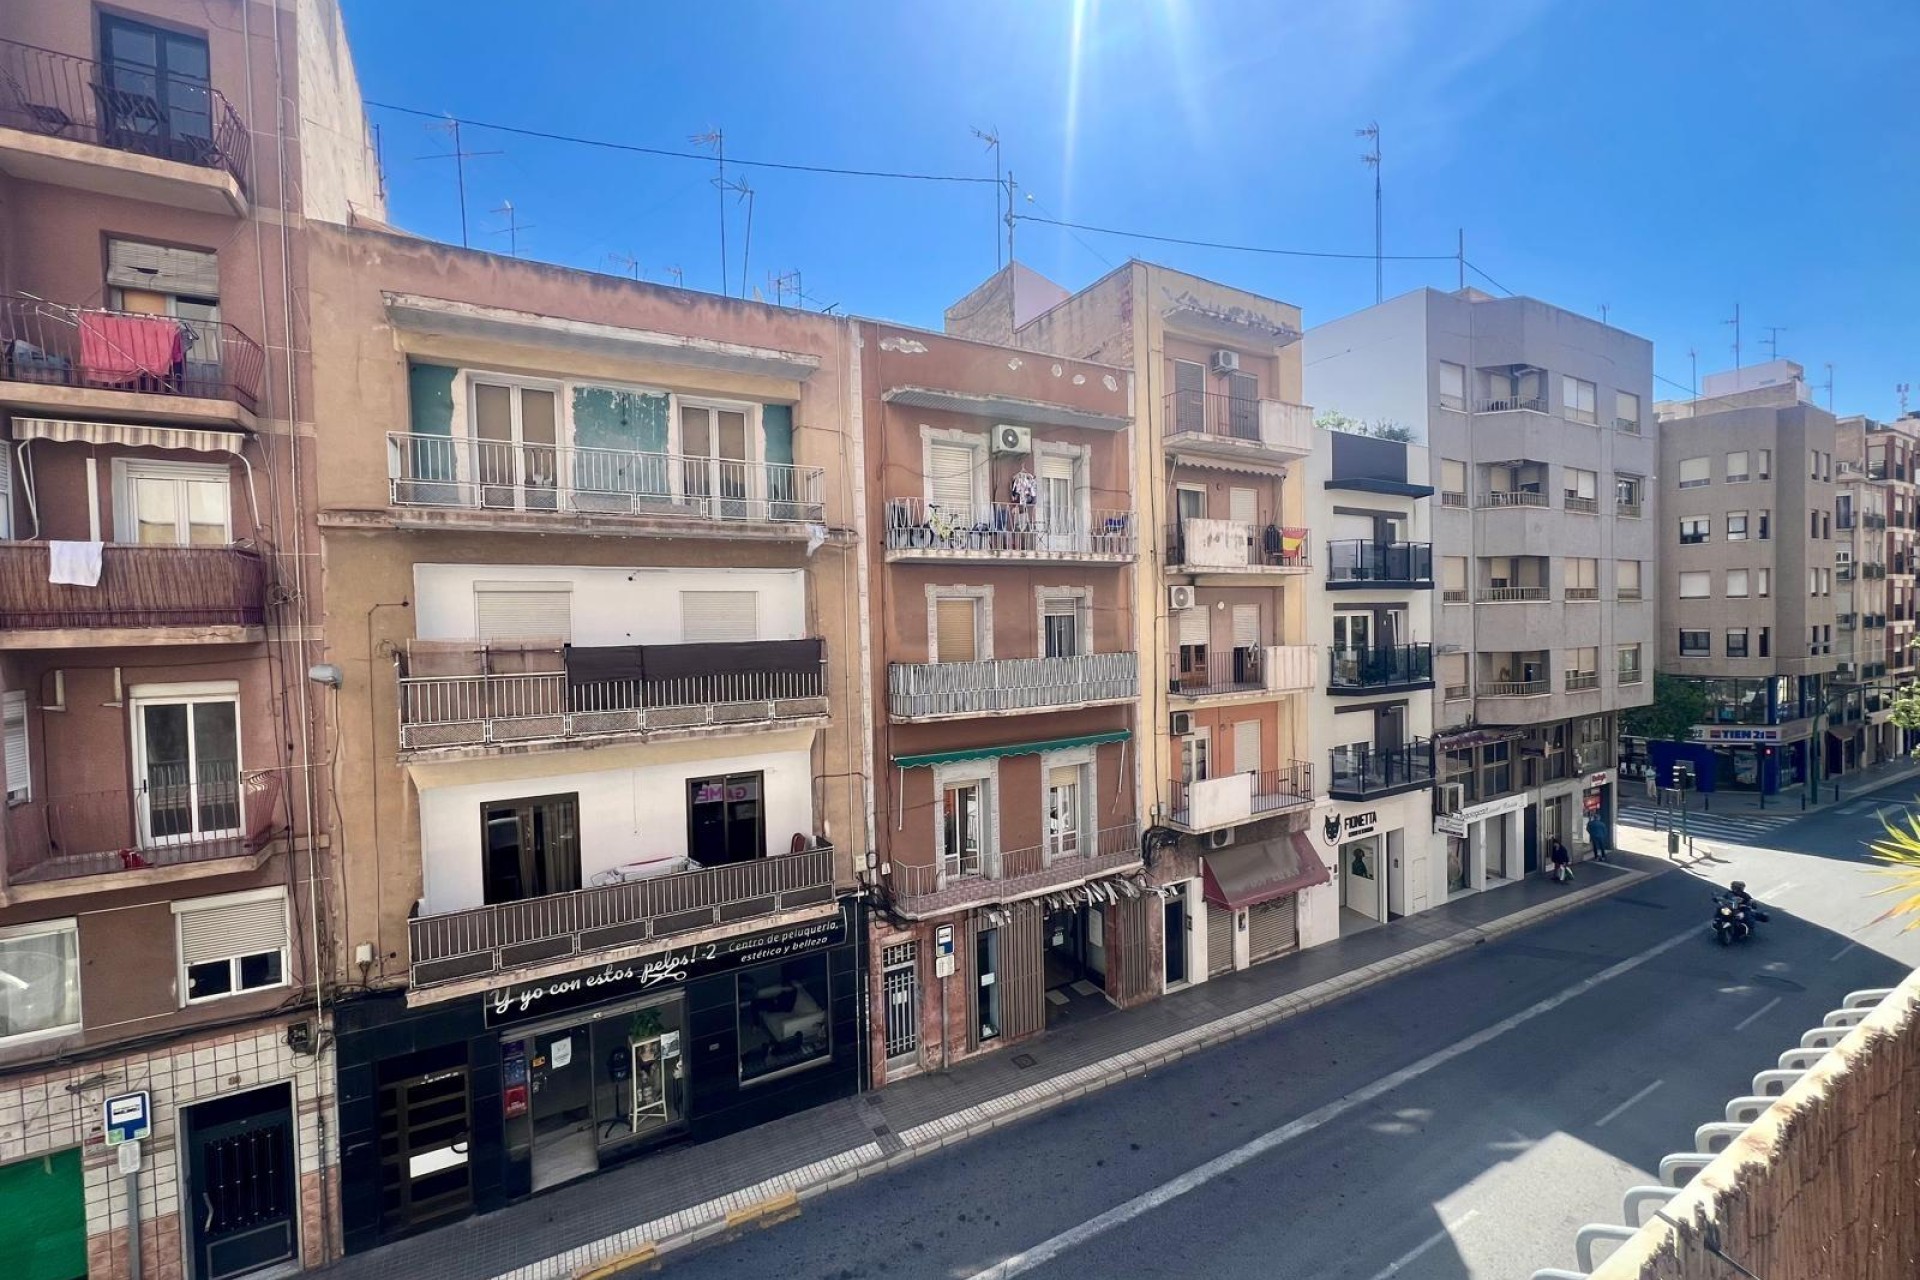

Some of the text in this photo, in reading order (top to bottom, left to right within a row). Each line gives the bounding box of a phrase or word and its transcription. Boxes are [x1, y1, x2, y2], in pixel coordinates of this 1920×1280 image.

[729, 938, 764, 952] Centro
[767, 933, 780, 944] de
[740, 936, 828, 963] estética y belleza
[489, 987, 514, 1014] Y
[520, 987, 542, 1011] yo
[549, 977, 581, 995] con
[586, 964, 633, 987] estos
